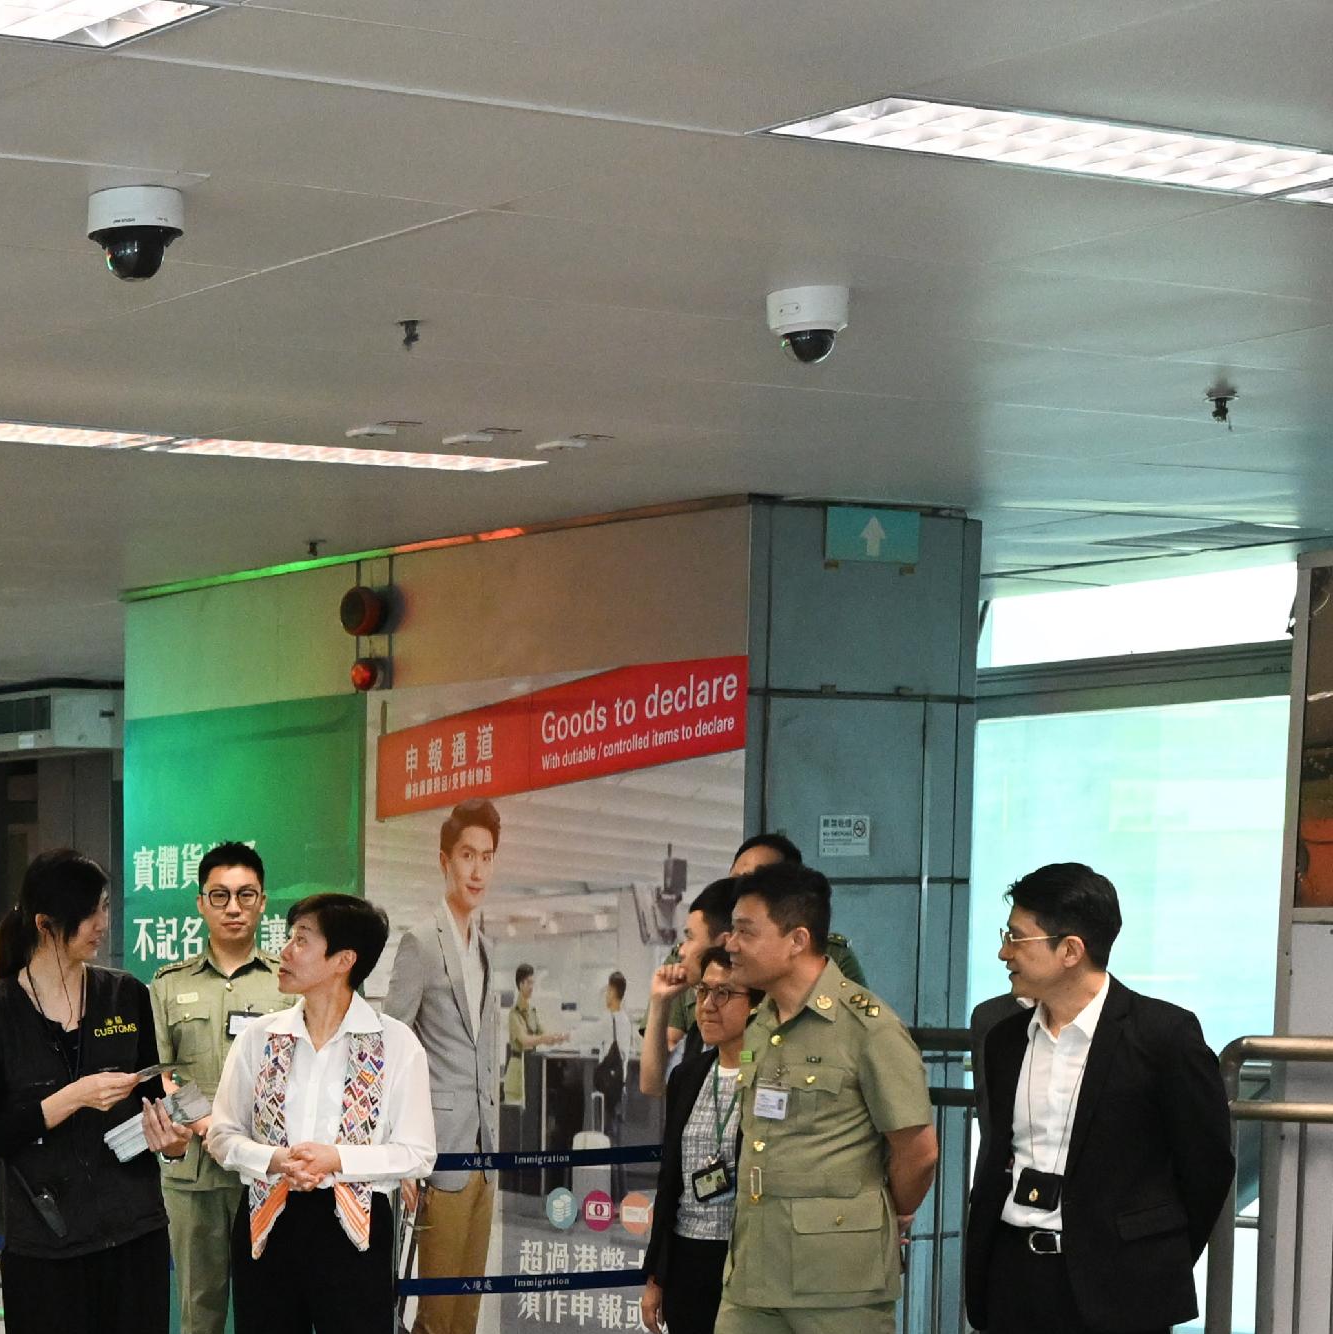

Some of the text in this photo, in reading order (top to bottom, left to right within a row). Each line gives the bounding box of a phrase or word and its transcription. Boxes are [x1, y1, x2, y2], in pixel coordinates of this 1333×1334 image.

[541, 673, 738, 744] Goods to declare
[405, 722, 493, 780] 申報通道
[541, 751, 561, 770] With
[562, 743, 596, 767] dutiable
[603, 731, 649, 757] controlled
[652, 726, 679, 747] items
[681, 724, 692, 740] to
[695, 715, 734, 738] declare
[94, 1023, 137, 1037] CUSTOMS
[514, 1153, 570, 1167] Immigration
[514, 1277, 570, 1289] Immigration
